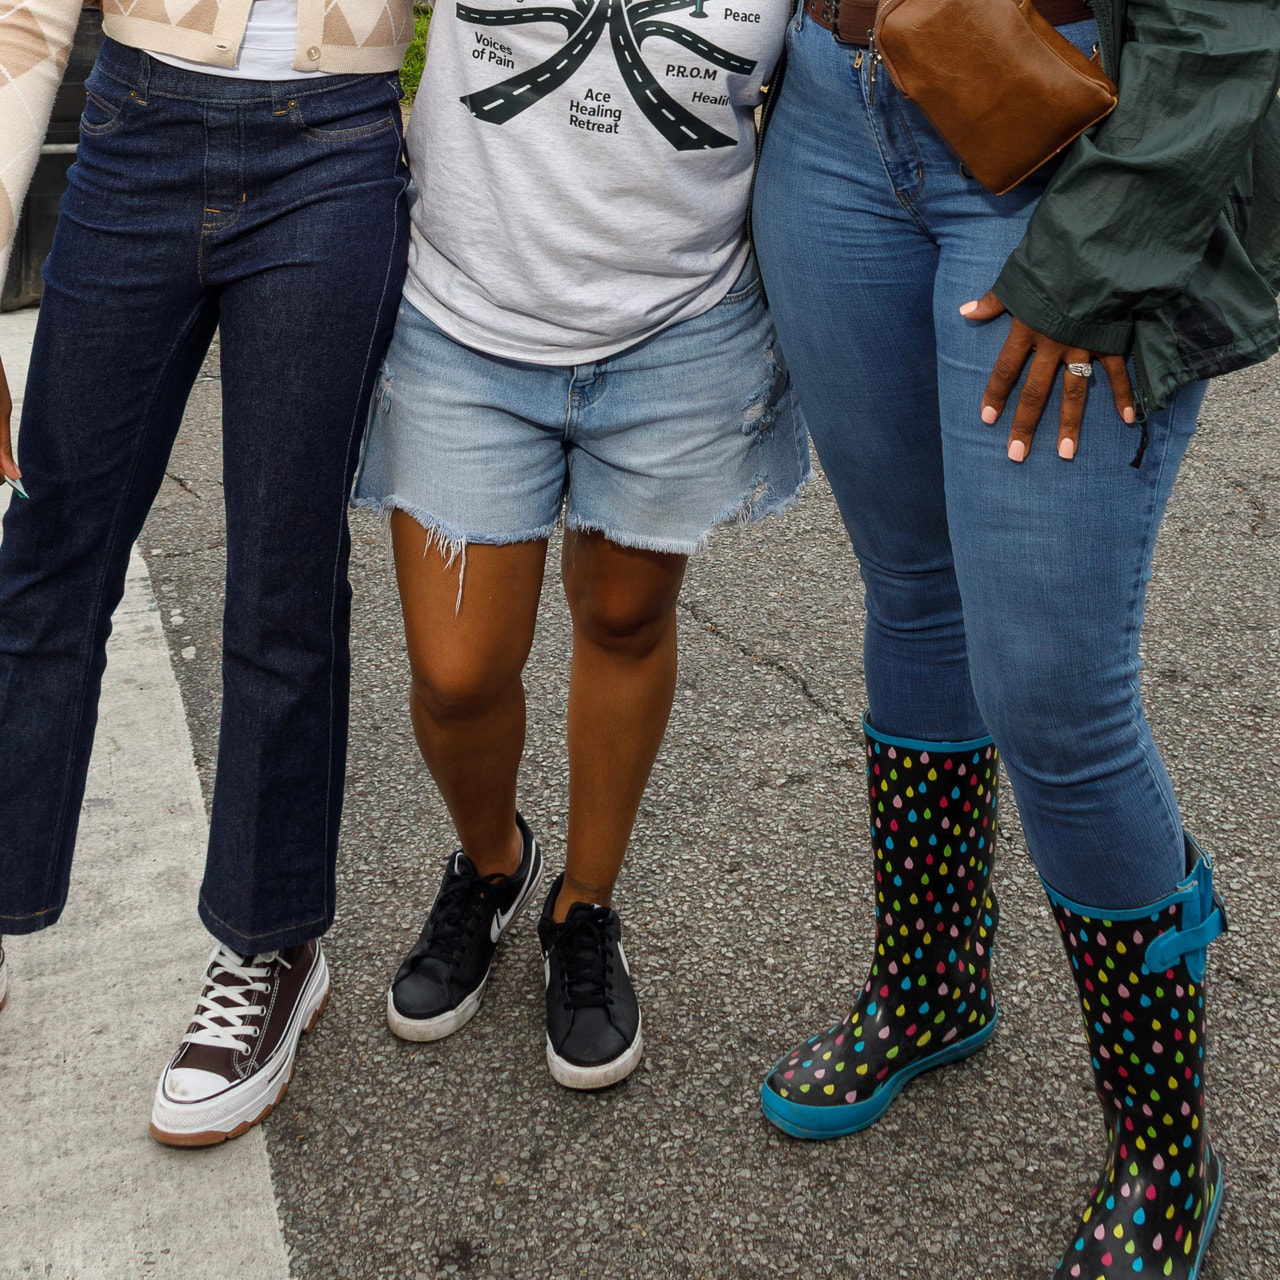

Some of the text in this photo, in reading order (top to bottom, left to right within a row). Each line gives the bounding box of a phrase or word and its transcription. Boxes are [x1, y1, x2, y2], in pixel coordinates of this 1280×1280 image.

[724, 7, 761, 24] Peace
[474, 31, 513, 55] Voices
[472, 46, 515, 69] of Pain
[666, 64, 718, 81] P.R.O.M
[584, 88, 611, 103] Ace
[569, 100, 622, 122] Healing
[569, 115, 619, 134] Retreat
